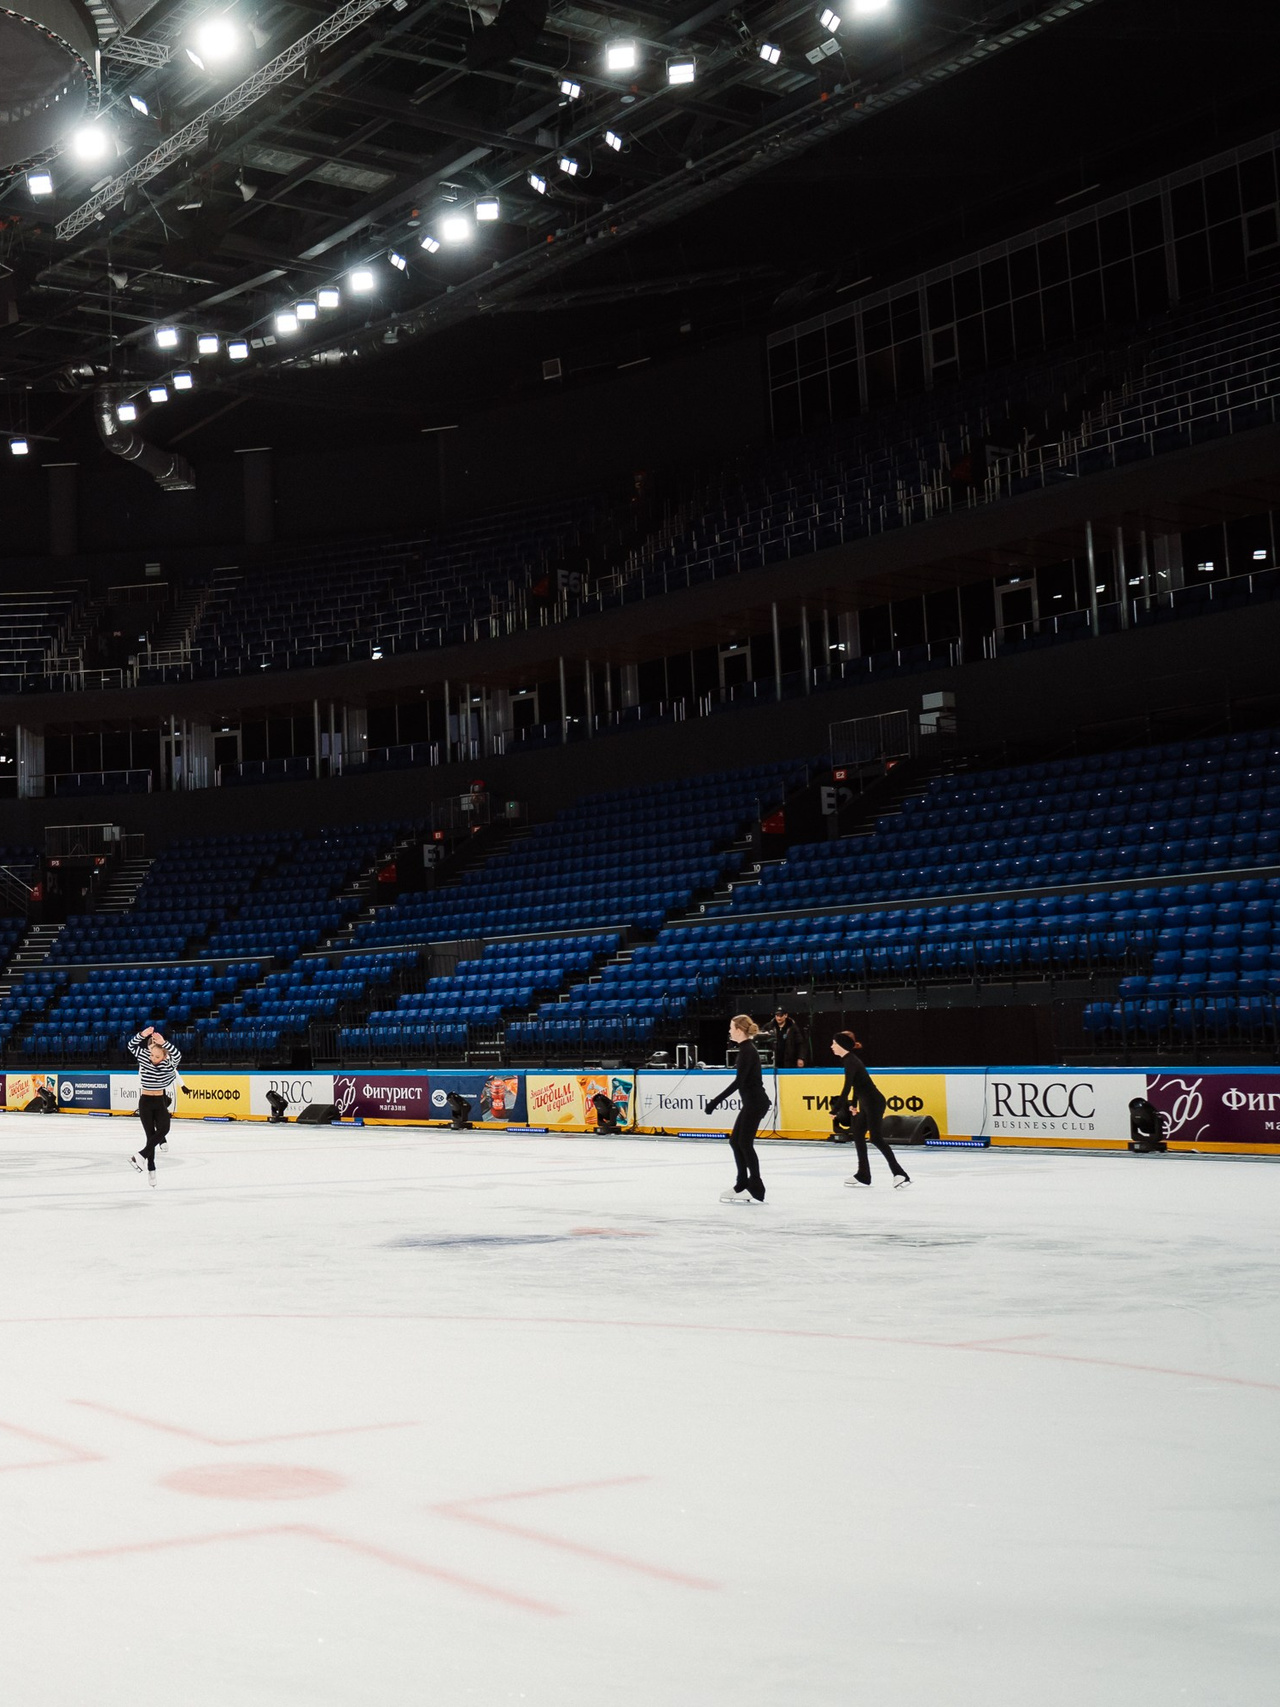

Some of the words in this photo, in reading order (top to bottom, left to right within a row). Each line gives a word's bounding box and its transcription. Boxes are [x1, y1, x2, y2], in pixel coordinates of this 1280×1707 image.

[188, 1089, 241, 1100] ТИНЬКОФФ
[362, 1084, 423, 1101] Фигурист
[991, 1082, 1096, 1119] RRCC
[657, 1093, 694, 1110] Team
[994, 1120, 1057, 1130] BUSINESS
[1062, 1121, 1095, 1131] CLUB
